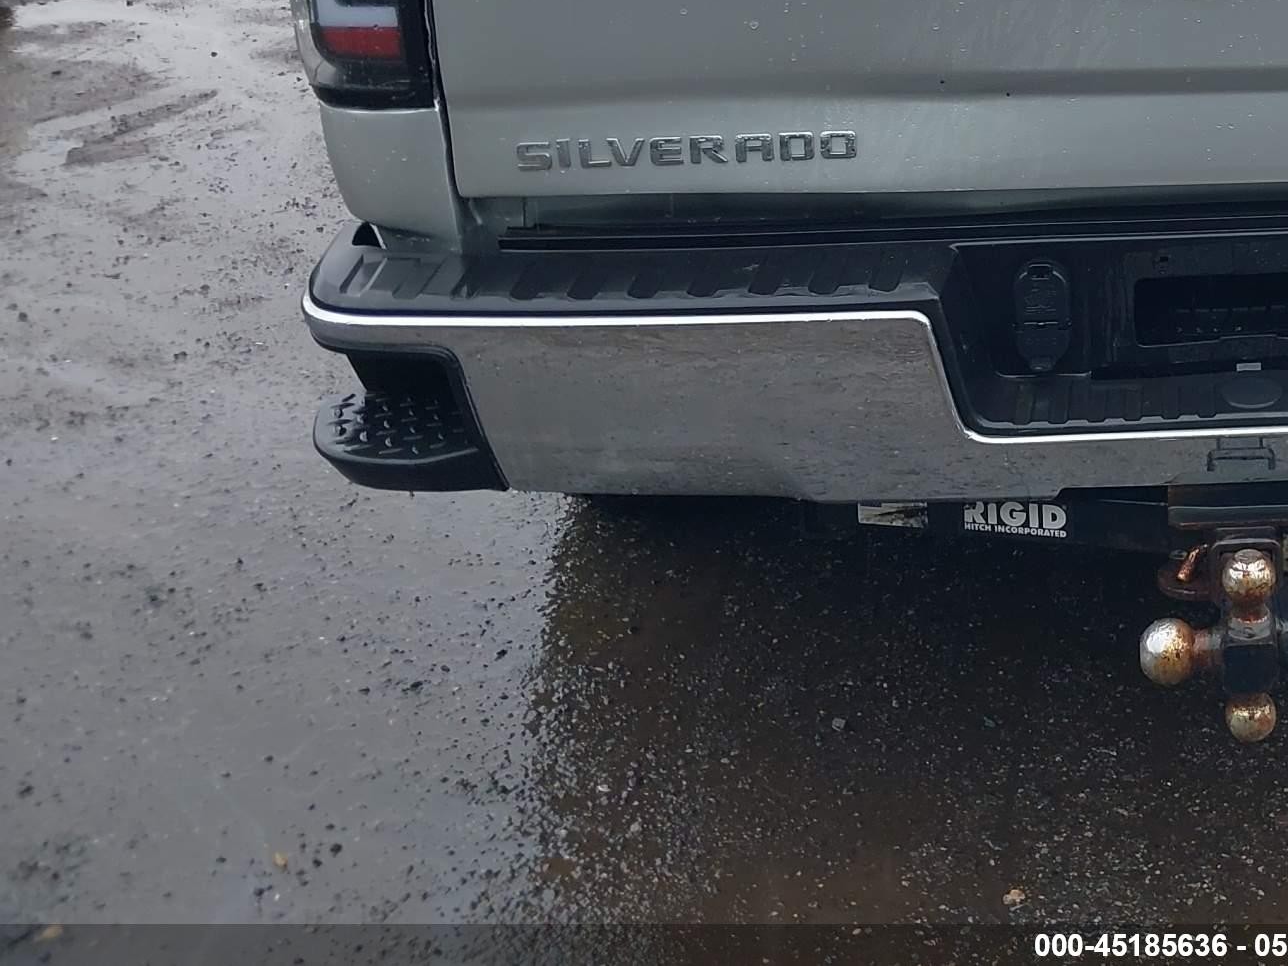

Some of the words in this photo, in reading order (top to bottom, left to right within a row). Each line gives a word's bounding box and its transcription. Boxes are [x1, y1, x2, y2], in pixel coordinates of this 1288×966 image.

[514, 129, 857, 172] SILVERADO
[964, 500, 1067, 530] RIGID
[964, 523, 992, 532] HITCH
[994, 525, 1067, 538] INCORPORATED
